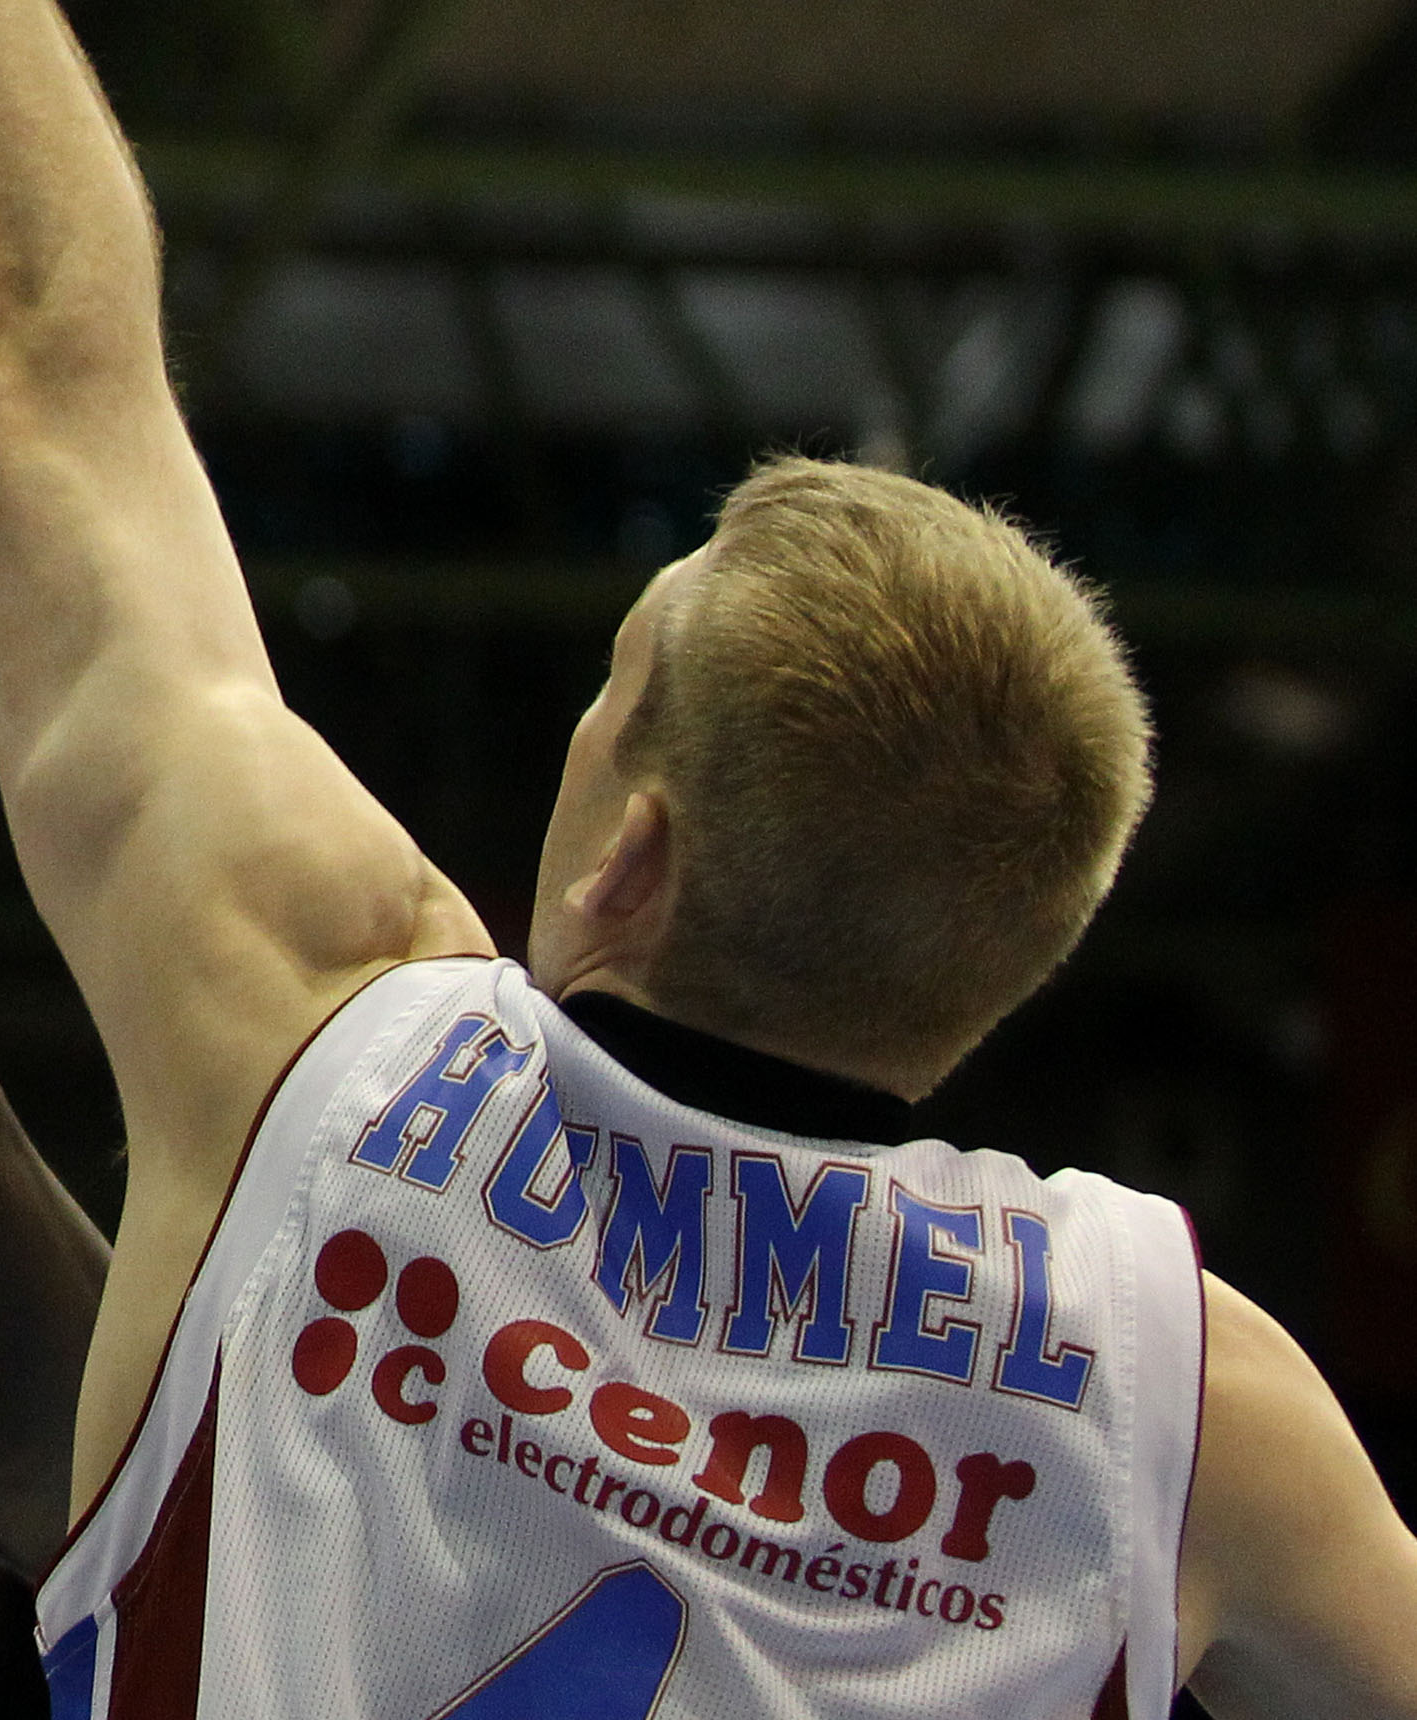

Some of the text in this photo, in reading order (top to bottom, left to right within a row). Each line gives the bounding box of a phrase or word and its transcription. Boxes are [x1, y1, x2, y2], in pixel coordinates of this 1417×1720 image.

[350, 1014, 1095, 1411] HUMMEL
[461, 1416, 1005, 1632] electrodomésticos
[483, 1319, 1036, 1562] cenor
